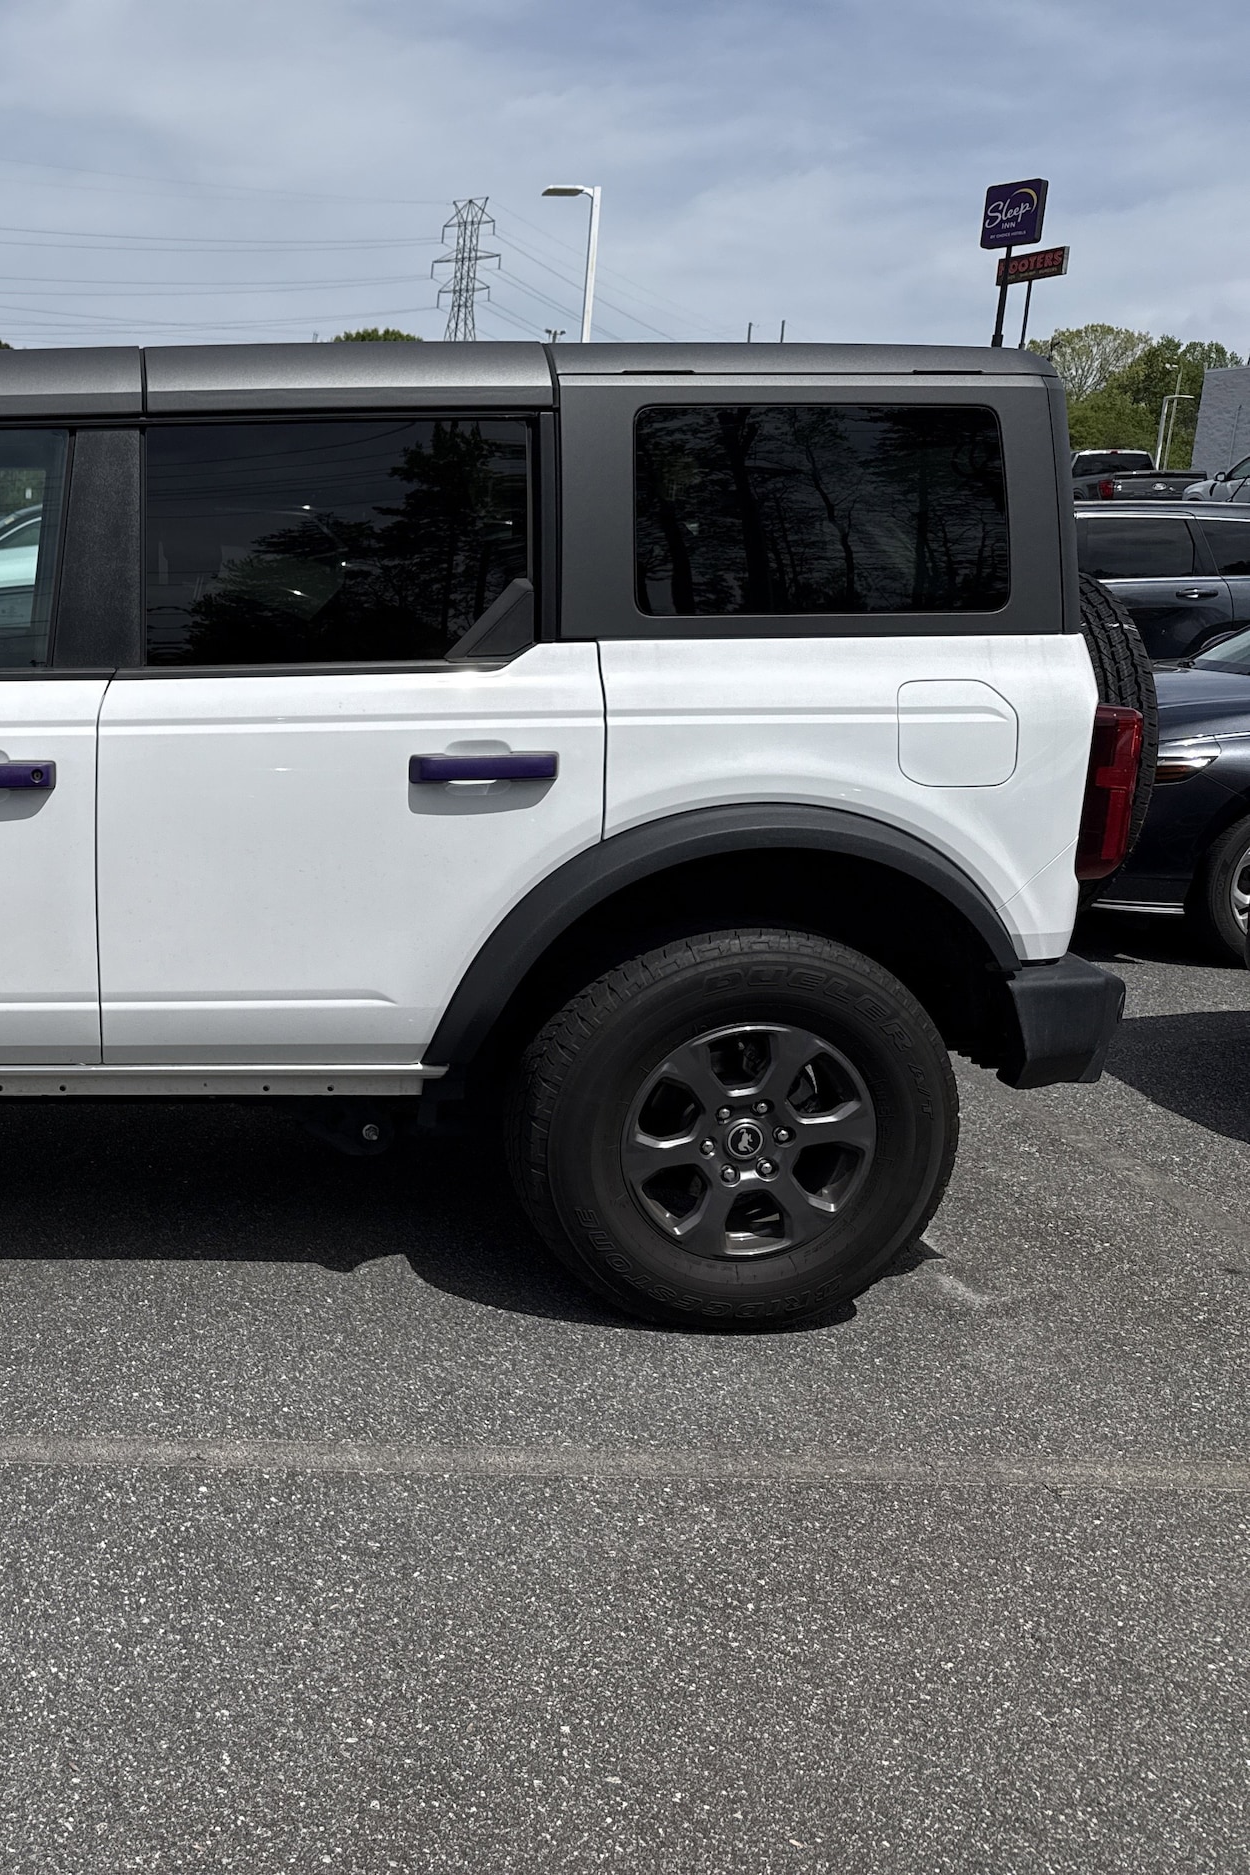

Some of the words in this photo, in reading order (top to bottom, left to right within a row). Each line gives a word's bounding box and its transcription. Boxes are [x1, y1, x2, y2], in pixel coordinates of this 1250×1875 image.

[985, 198, 1031, 228] Sleep
[1001, 221, 1016, 229] INN
[702, 965, 914, 1052] DUELER
[907, 1062, 936, 1120] A/T
[574, 1207, 843, 1318] BRIDGESTONE
